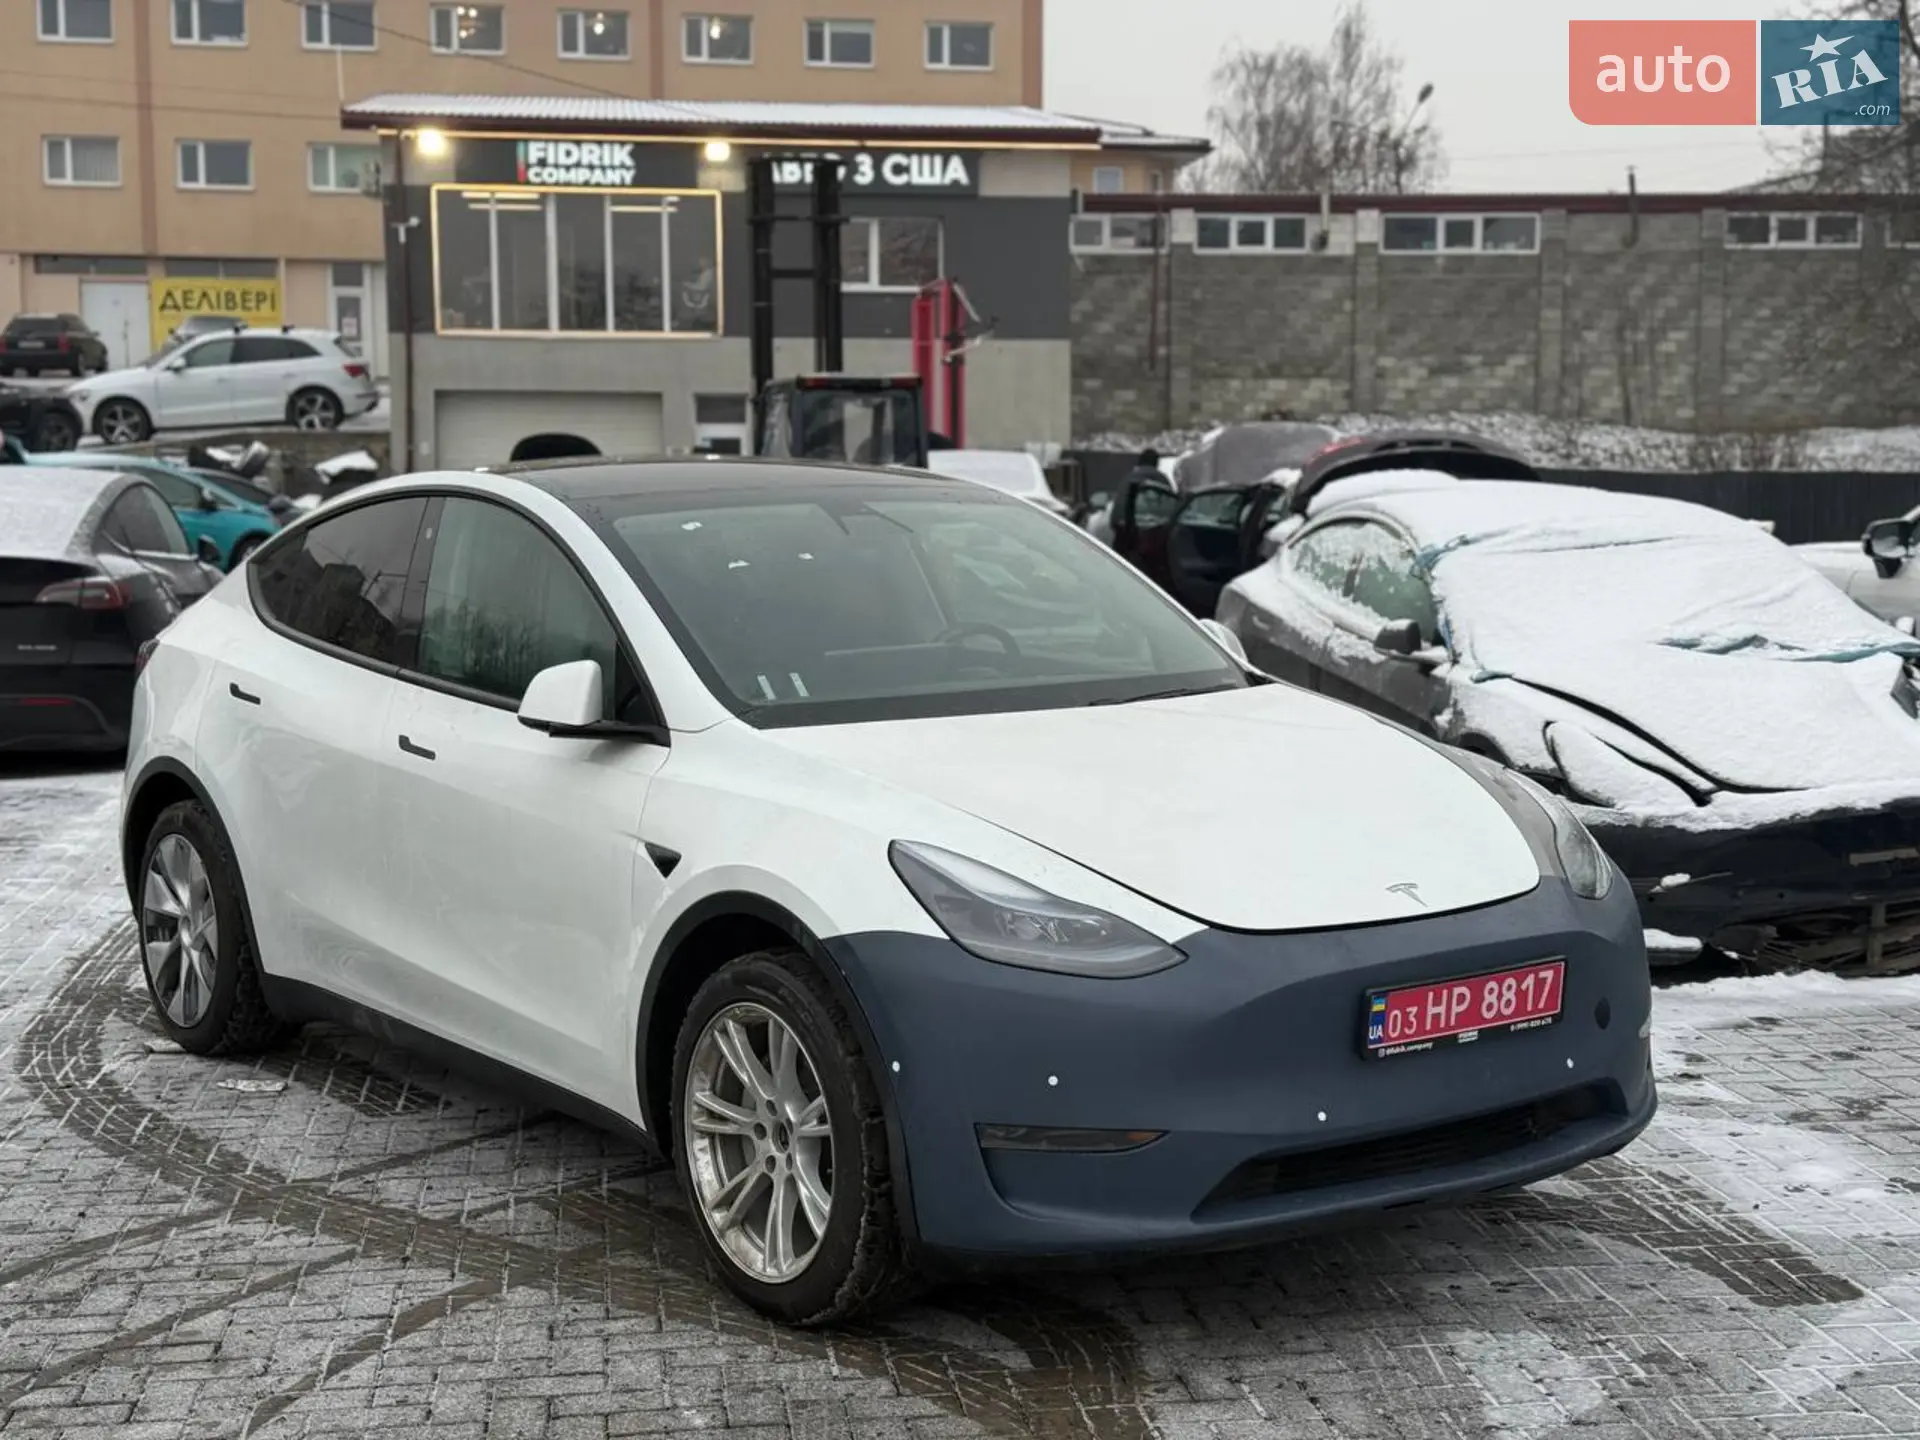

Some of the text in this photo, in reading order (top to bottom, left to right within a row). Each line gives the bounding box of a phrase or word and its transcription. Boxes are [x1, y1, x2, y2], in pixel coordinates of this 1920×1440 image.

[528, 141, 635, 167] FIDRIK
[528, 166, 636, 185] COMPANY
[882, 153, 969, 186] США
[159, 288, 276, 312] ДЕЛІВЕРІ
[1388, 970, 1554, 1038] 03 HP 8817
[1368, 1024, 1384, 1039] UA
